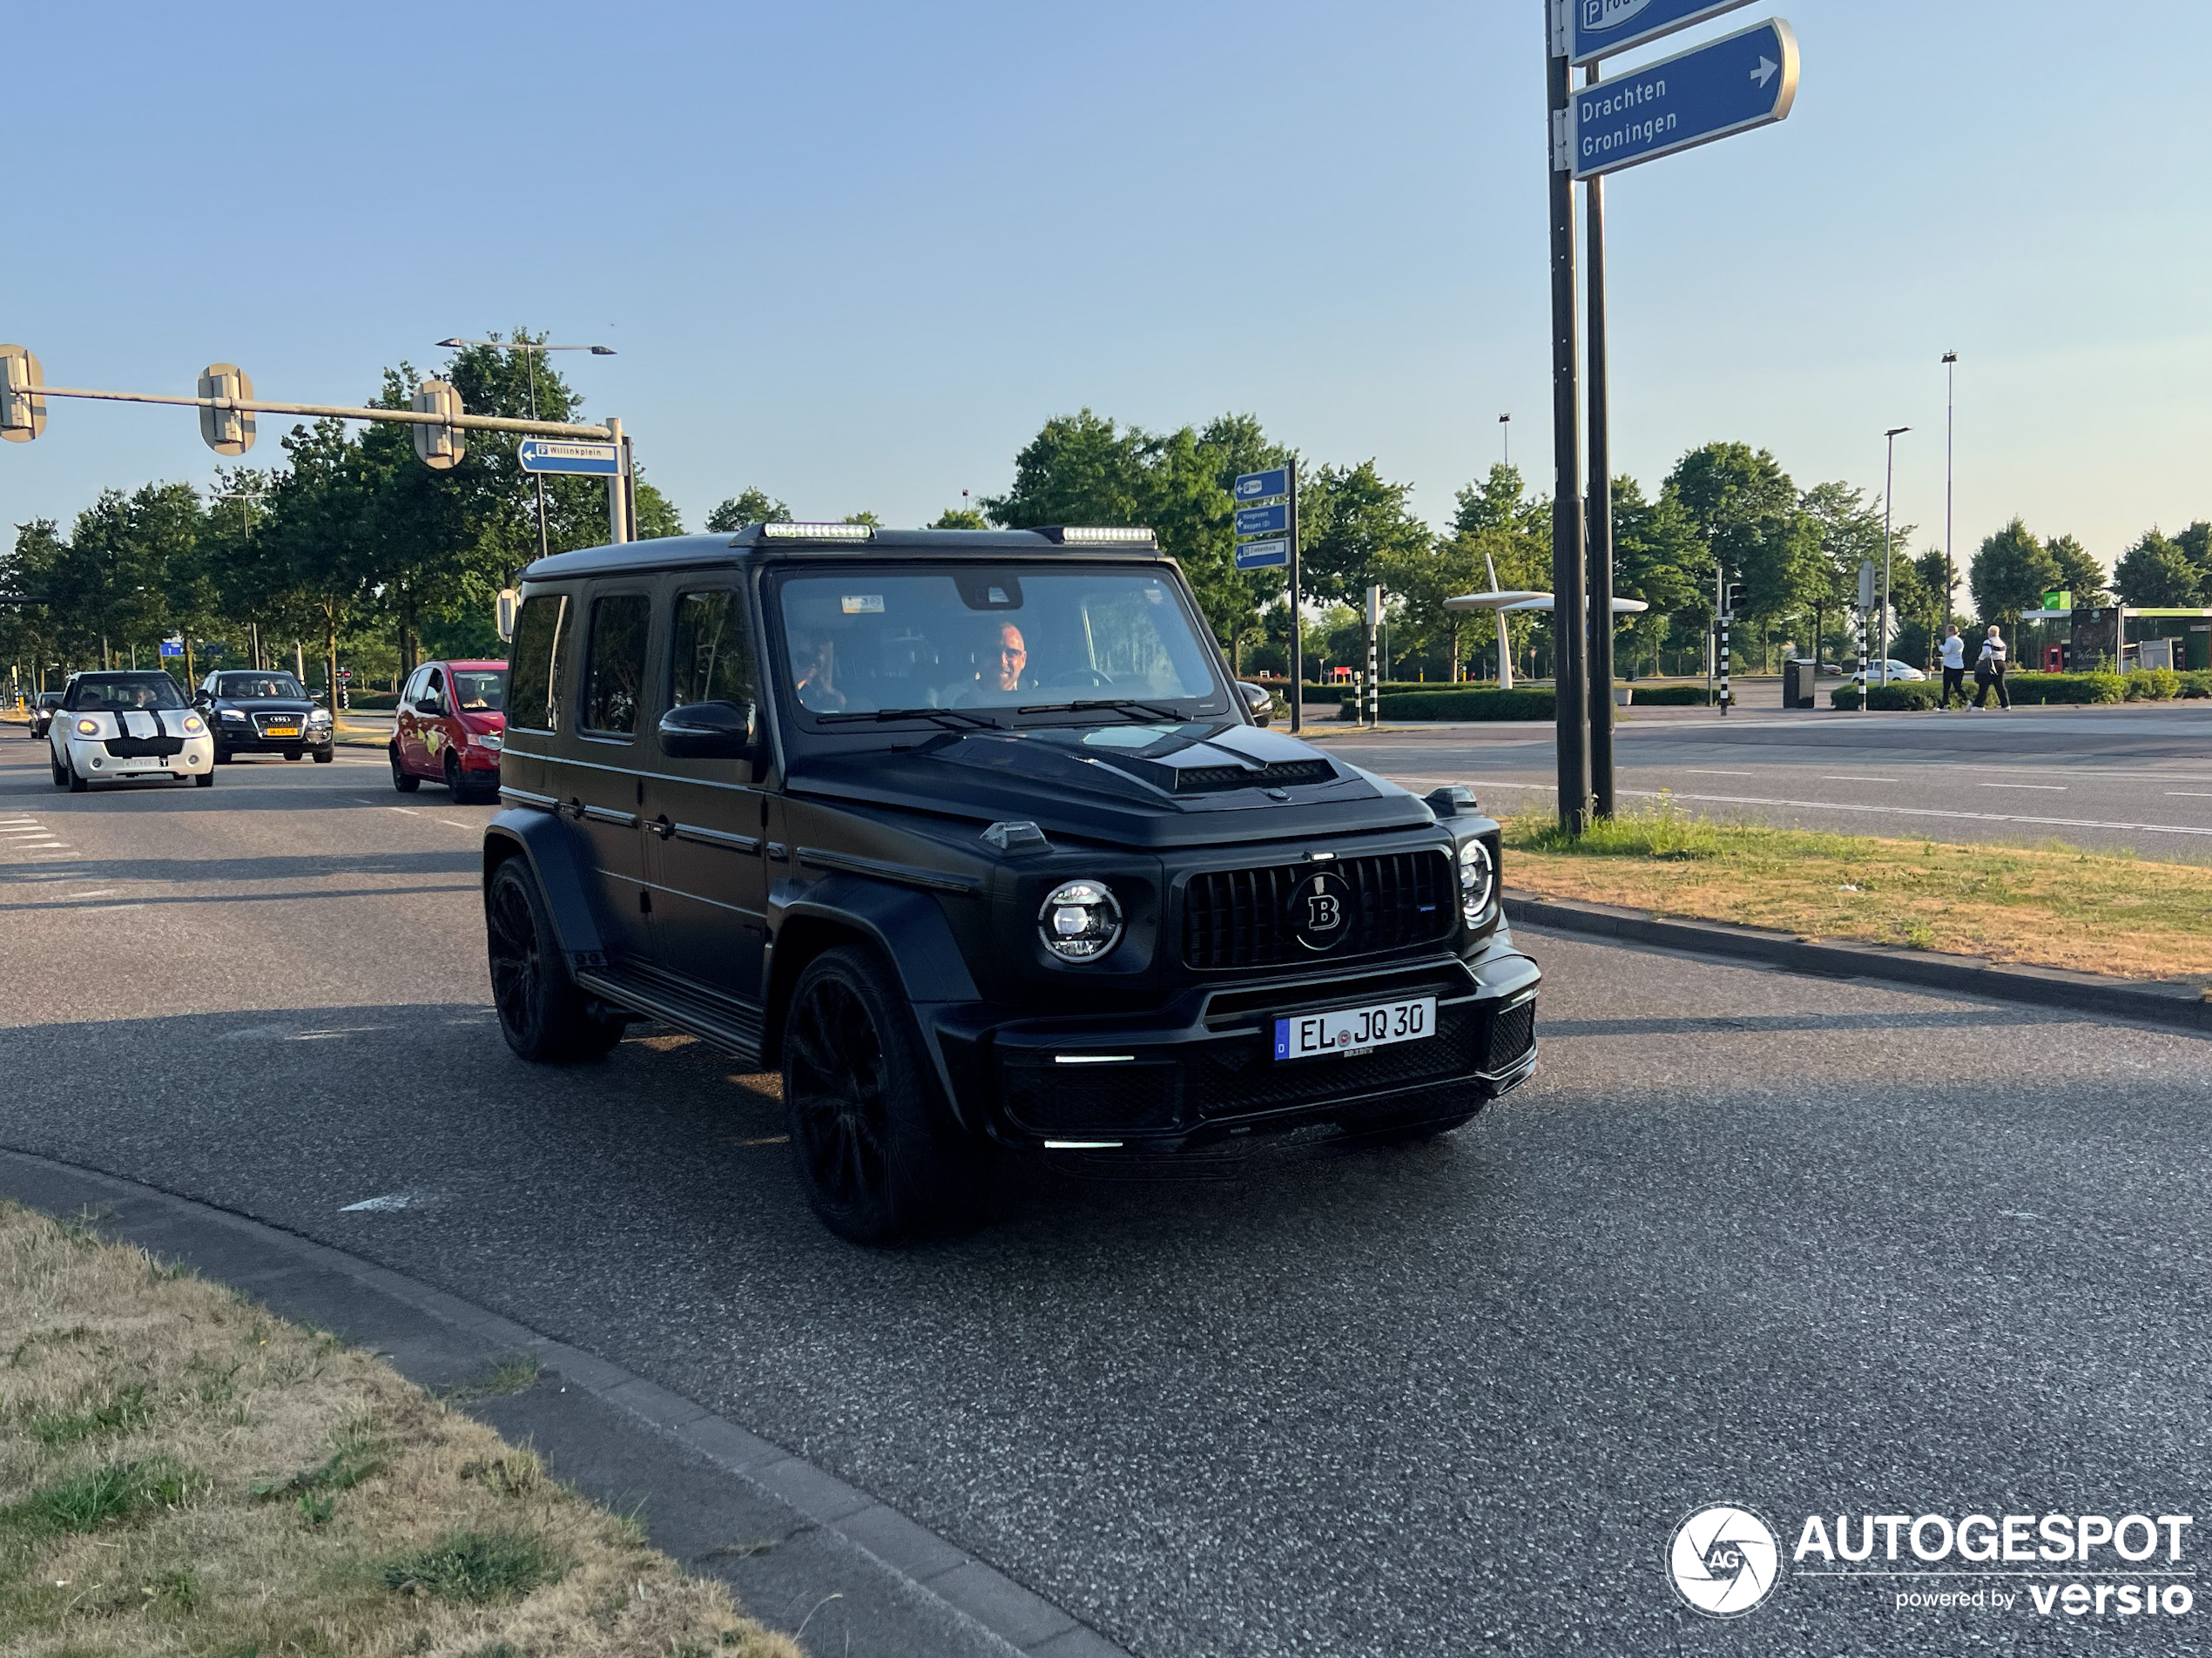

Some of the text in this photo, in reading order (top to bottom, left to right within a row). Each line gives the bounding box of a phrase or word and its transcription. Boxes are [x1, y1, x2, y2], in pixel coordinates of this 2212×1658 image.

[1581, 80, 1666, 123] Drachten
[1582, 112, 1676, 157] Groningen
[550, 446, 602, 456] Willinkplein
[1308, 894, 1341, 931] B
[1301, 1003, 1424, 1052] EL JQ 30
